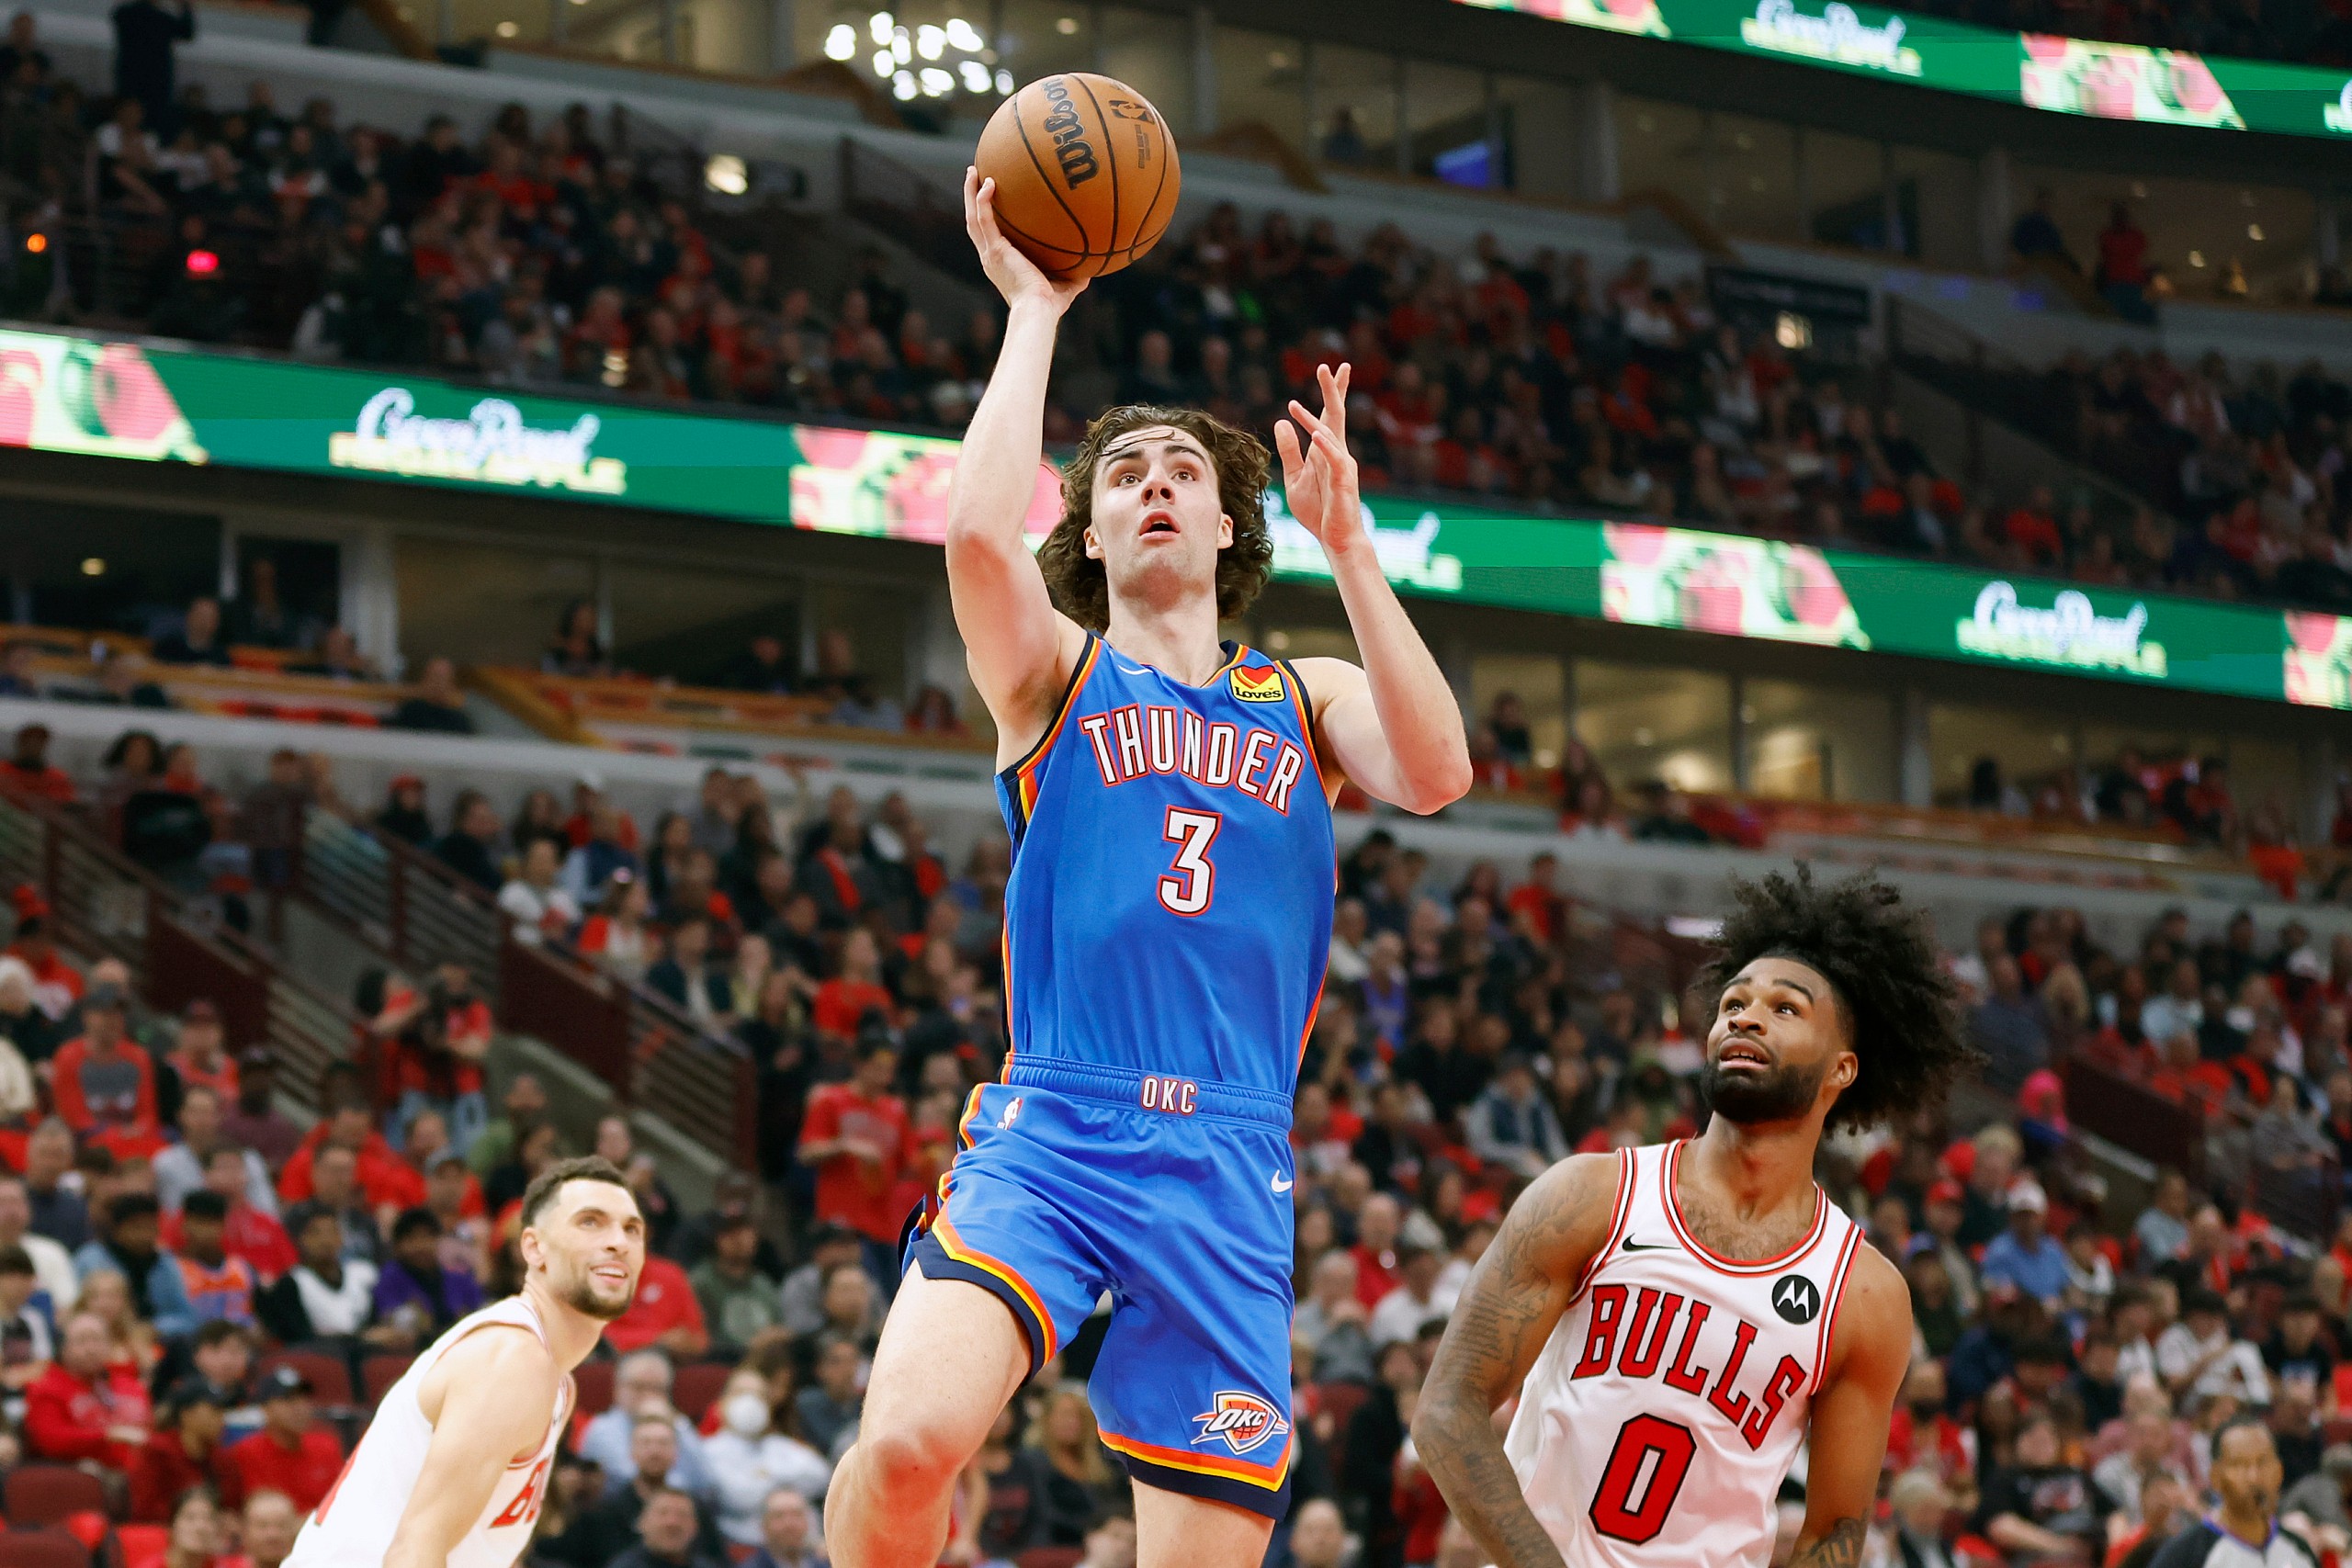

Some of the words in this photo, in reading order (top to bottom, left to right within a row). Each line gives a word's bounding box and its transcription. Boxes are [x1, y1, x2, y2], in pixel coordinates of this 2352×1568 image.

[1041, 77, 1100, 190] Wilson
[1078, 703, 1306, 817] THUNDER
[1156, 804, 1222, 918] 3
[1140, 1076, 1197, 1116] OKC
[1205, 1408, 1267, 1433] OKC
[1570, 1283, 1807, 1451] BULLS
[1589, 1413, 1697, 1546] 0
